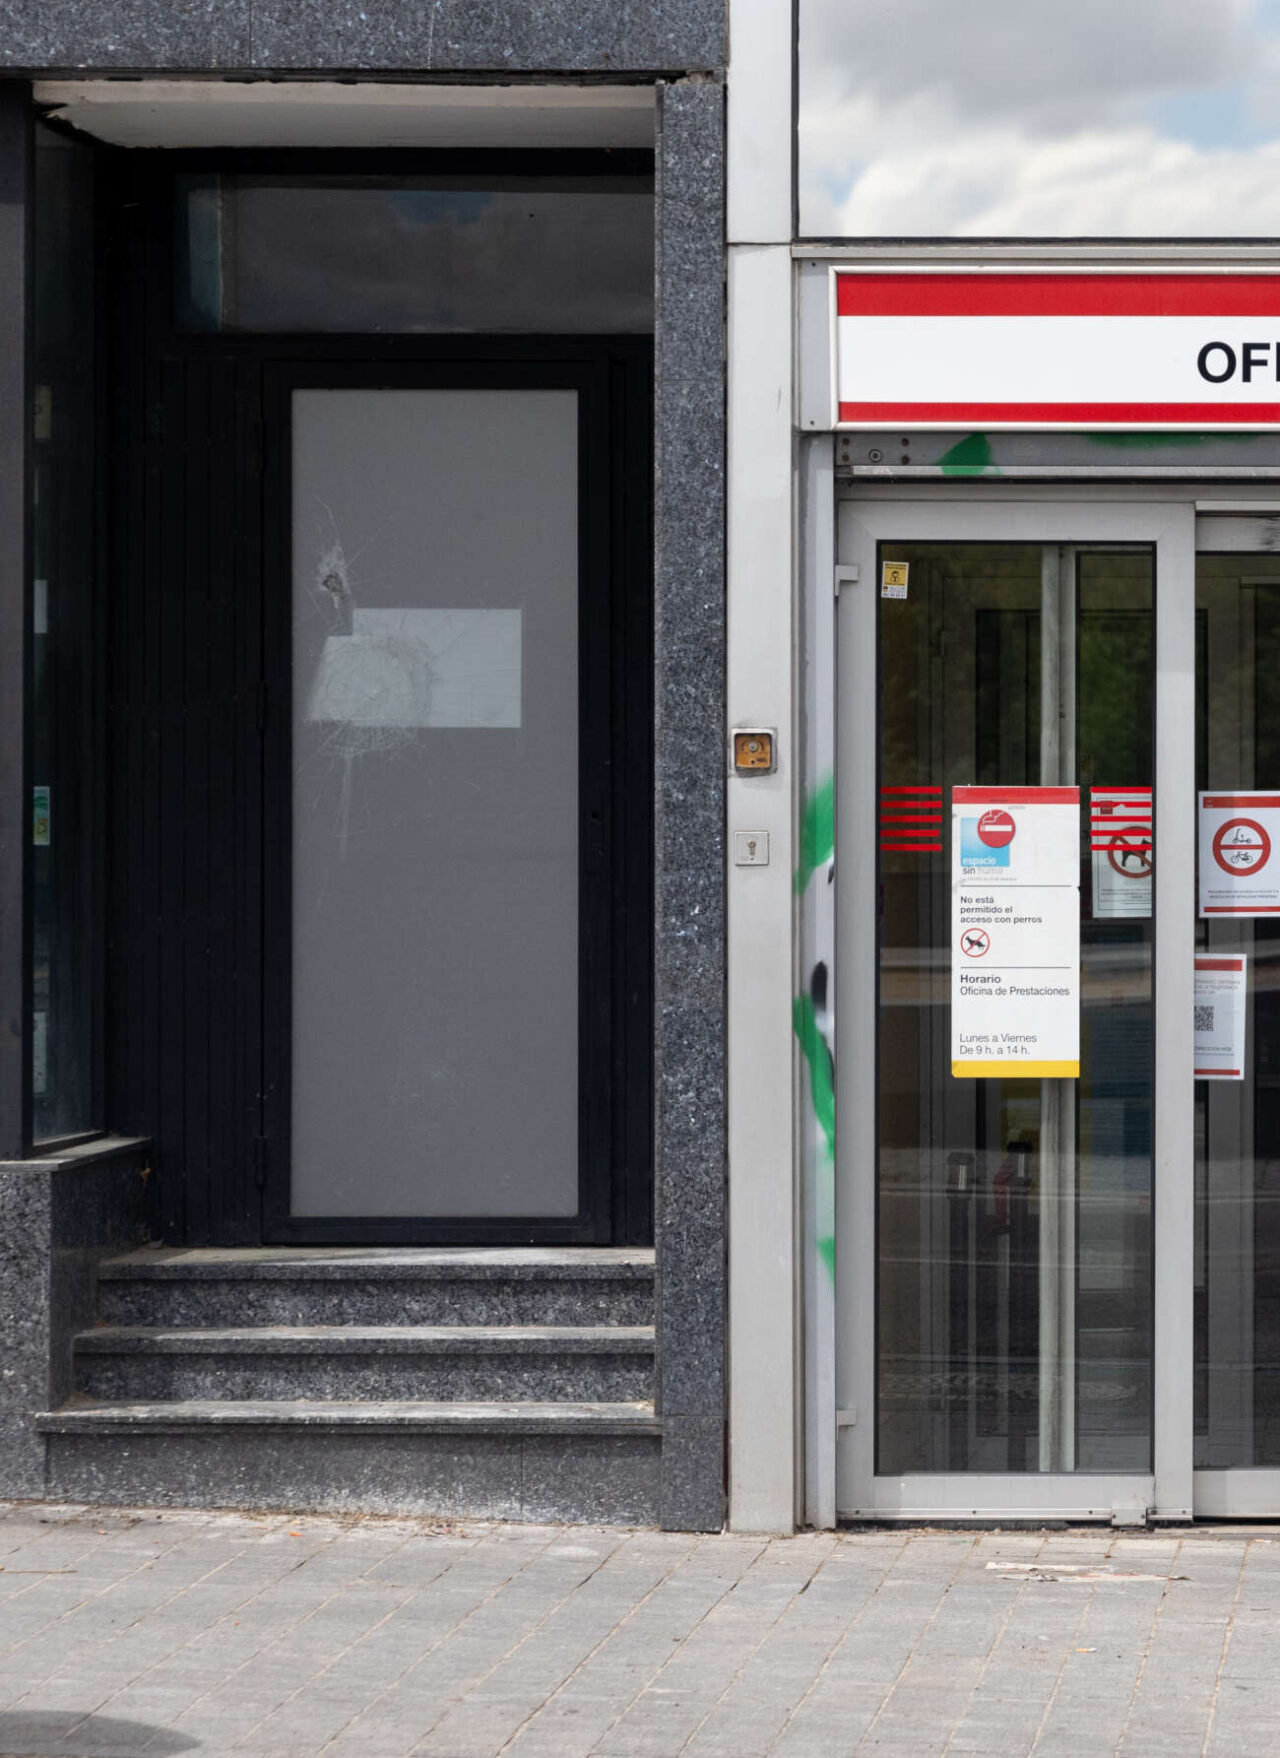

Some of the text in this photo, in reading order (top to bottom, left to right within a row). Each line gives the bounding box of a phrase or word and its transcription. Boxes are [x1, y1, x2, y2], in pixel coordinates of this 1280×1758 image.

[962, 856, 997, 866] espacio
[962, 866, 976, 875] sin
[960, 896, 994, 904] No está
[960, 906, 1013, 914] permitido el
[1013, 916, 1042, 925] perros
[960, 974, 1002, 984] Horario
[960, 986, 1070, 996] Oficina de Prestaciones
[959, 1033, 1038, 1043] Lunes a Viernes
[959, 1045, 1031, 1055] De 9 h. a 14 h.
